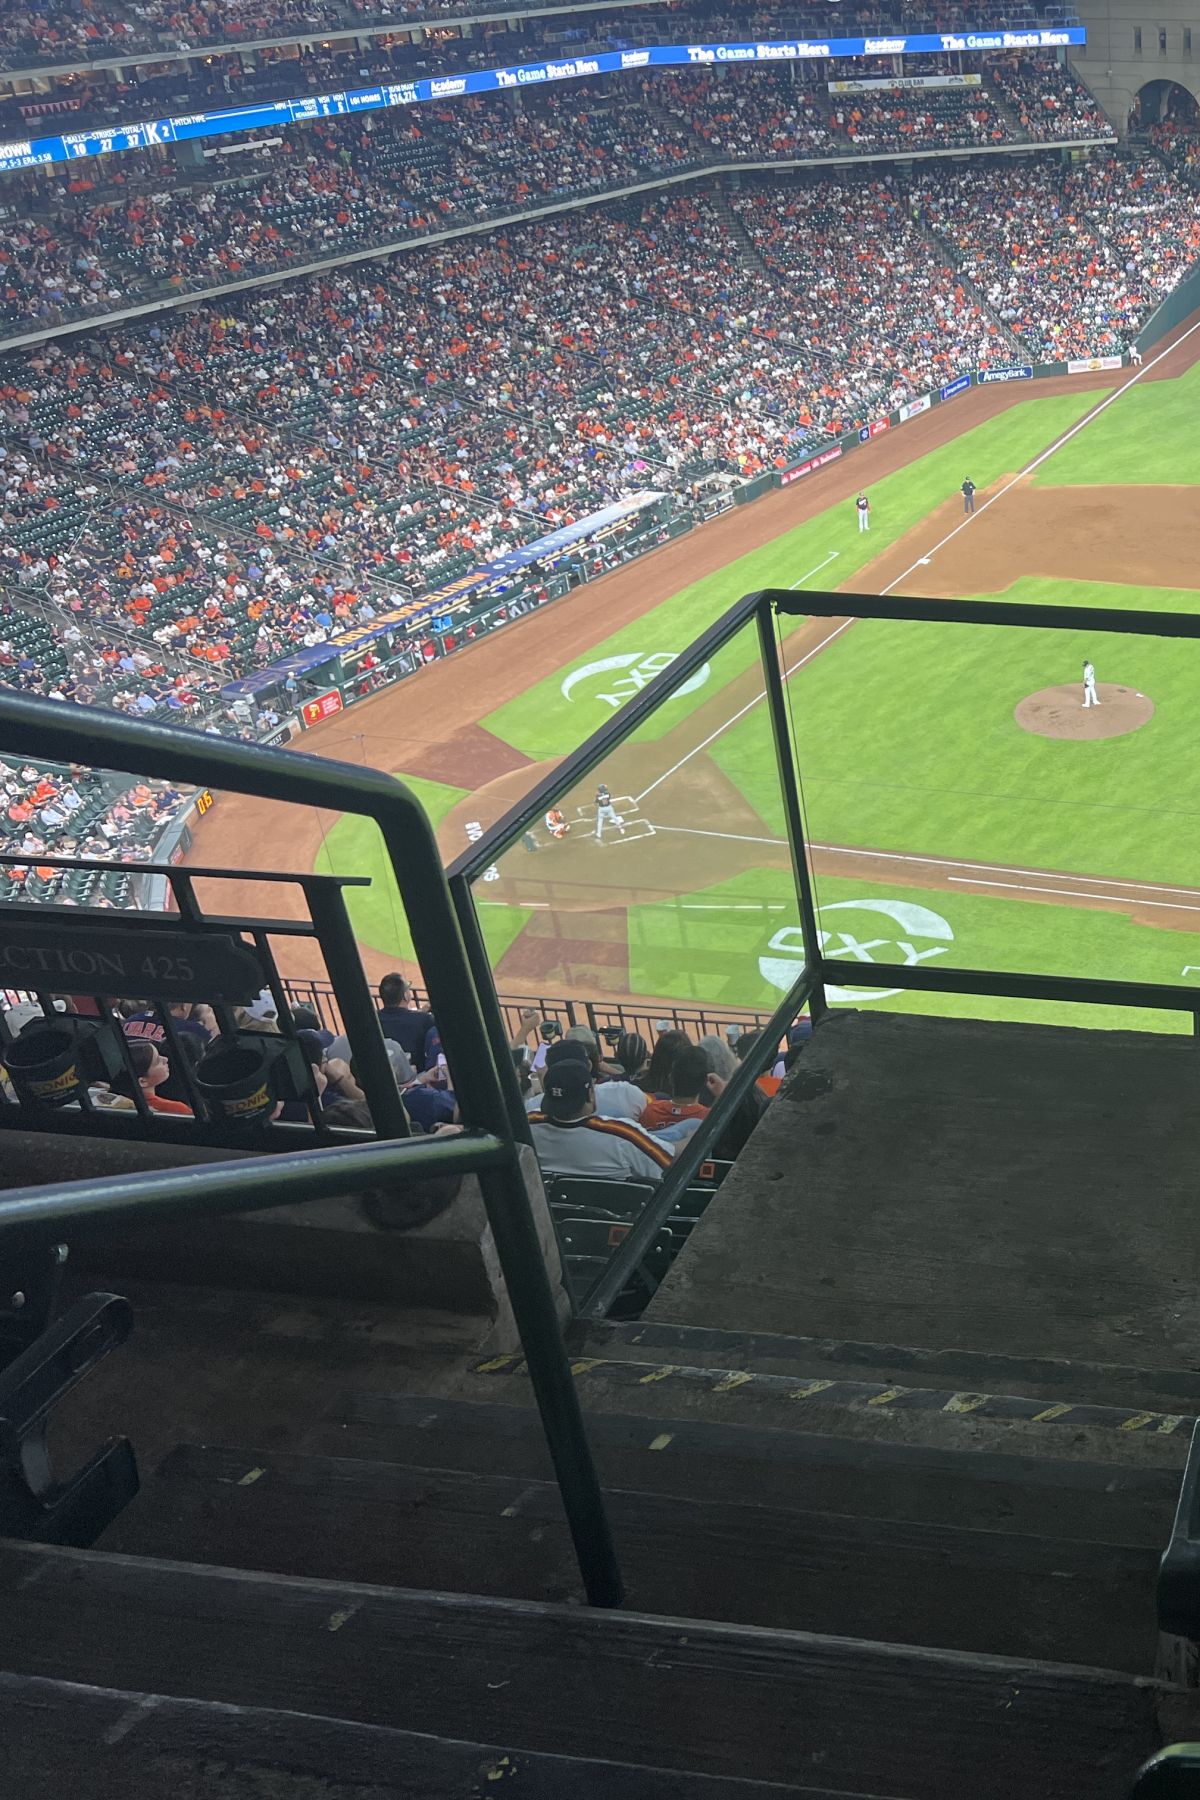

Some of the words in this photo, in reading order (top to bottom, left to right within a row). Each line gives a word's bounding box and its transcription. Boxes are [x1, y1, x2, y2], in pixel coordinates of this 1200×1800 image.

[941, 35, 967, 49] The
[966, 34, 1002, 48] Game
[1003, 33, 1043, 47] Starts
[1043, 32, 1070, 45] Here
[688, 47, 715, 61] The
[717, 46, 756, 60] Game
[757, 44, 797, 58] Starts
[798, 43, 830, 57] Here
[496, 71, 517, 87] The
[518, 69, 547, 83] Game
[547, 63, 576, 79] Starts
[575, 59, 600, 75] Here
[430, 78, 466, 94] Academy
[100, 138, 113, 151] 27
[127, 134, 140, 148] 37
[768, 925, 949, 968] OXY
[142, 955, 195, 981] 425
